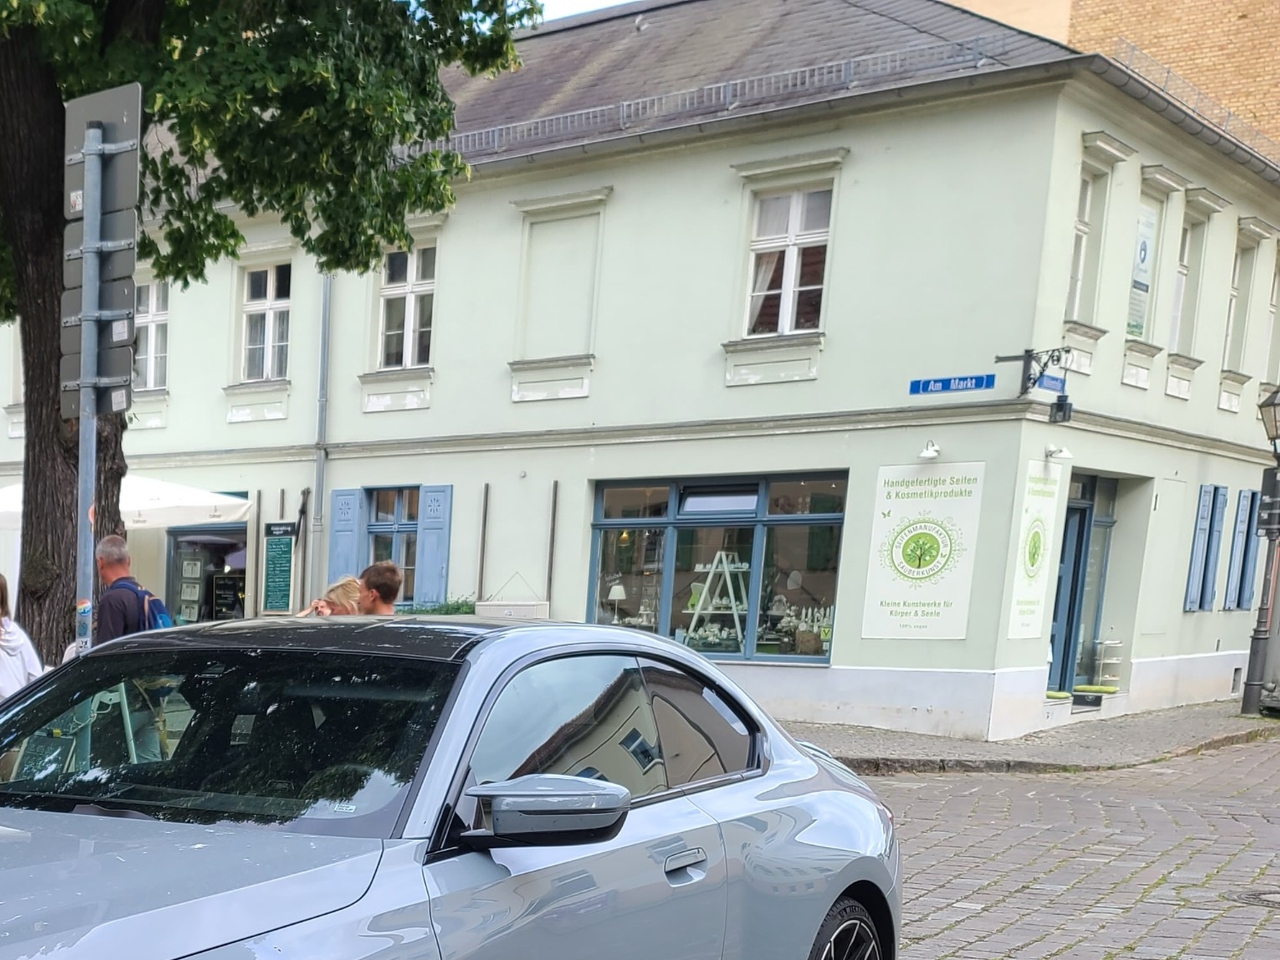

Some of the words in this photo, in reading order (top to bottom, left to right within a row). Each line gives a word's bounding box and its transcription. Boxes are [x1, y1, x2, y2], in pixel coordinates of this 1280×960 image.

[927, 380, 942, 391] Am
[950, 377, 976, 390] Markt
[883, 477, 947, 488] Handgefertigte
[949, 475, 978, 486] Seifen
[885, 491, 892, 500] &
[895, 488, 973, 500] Kosmetikprodukte
